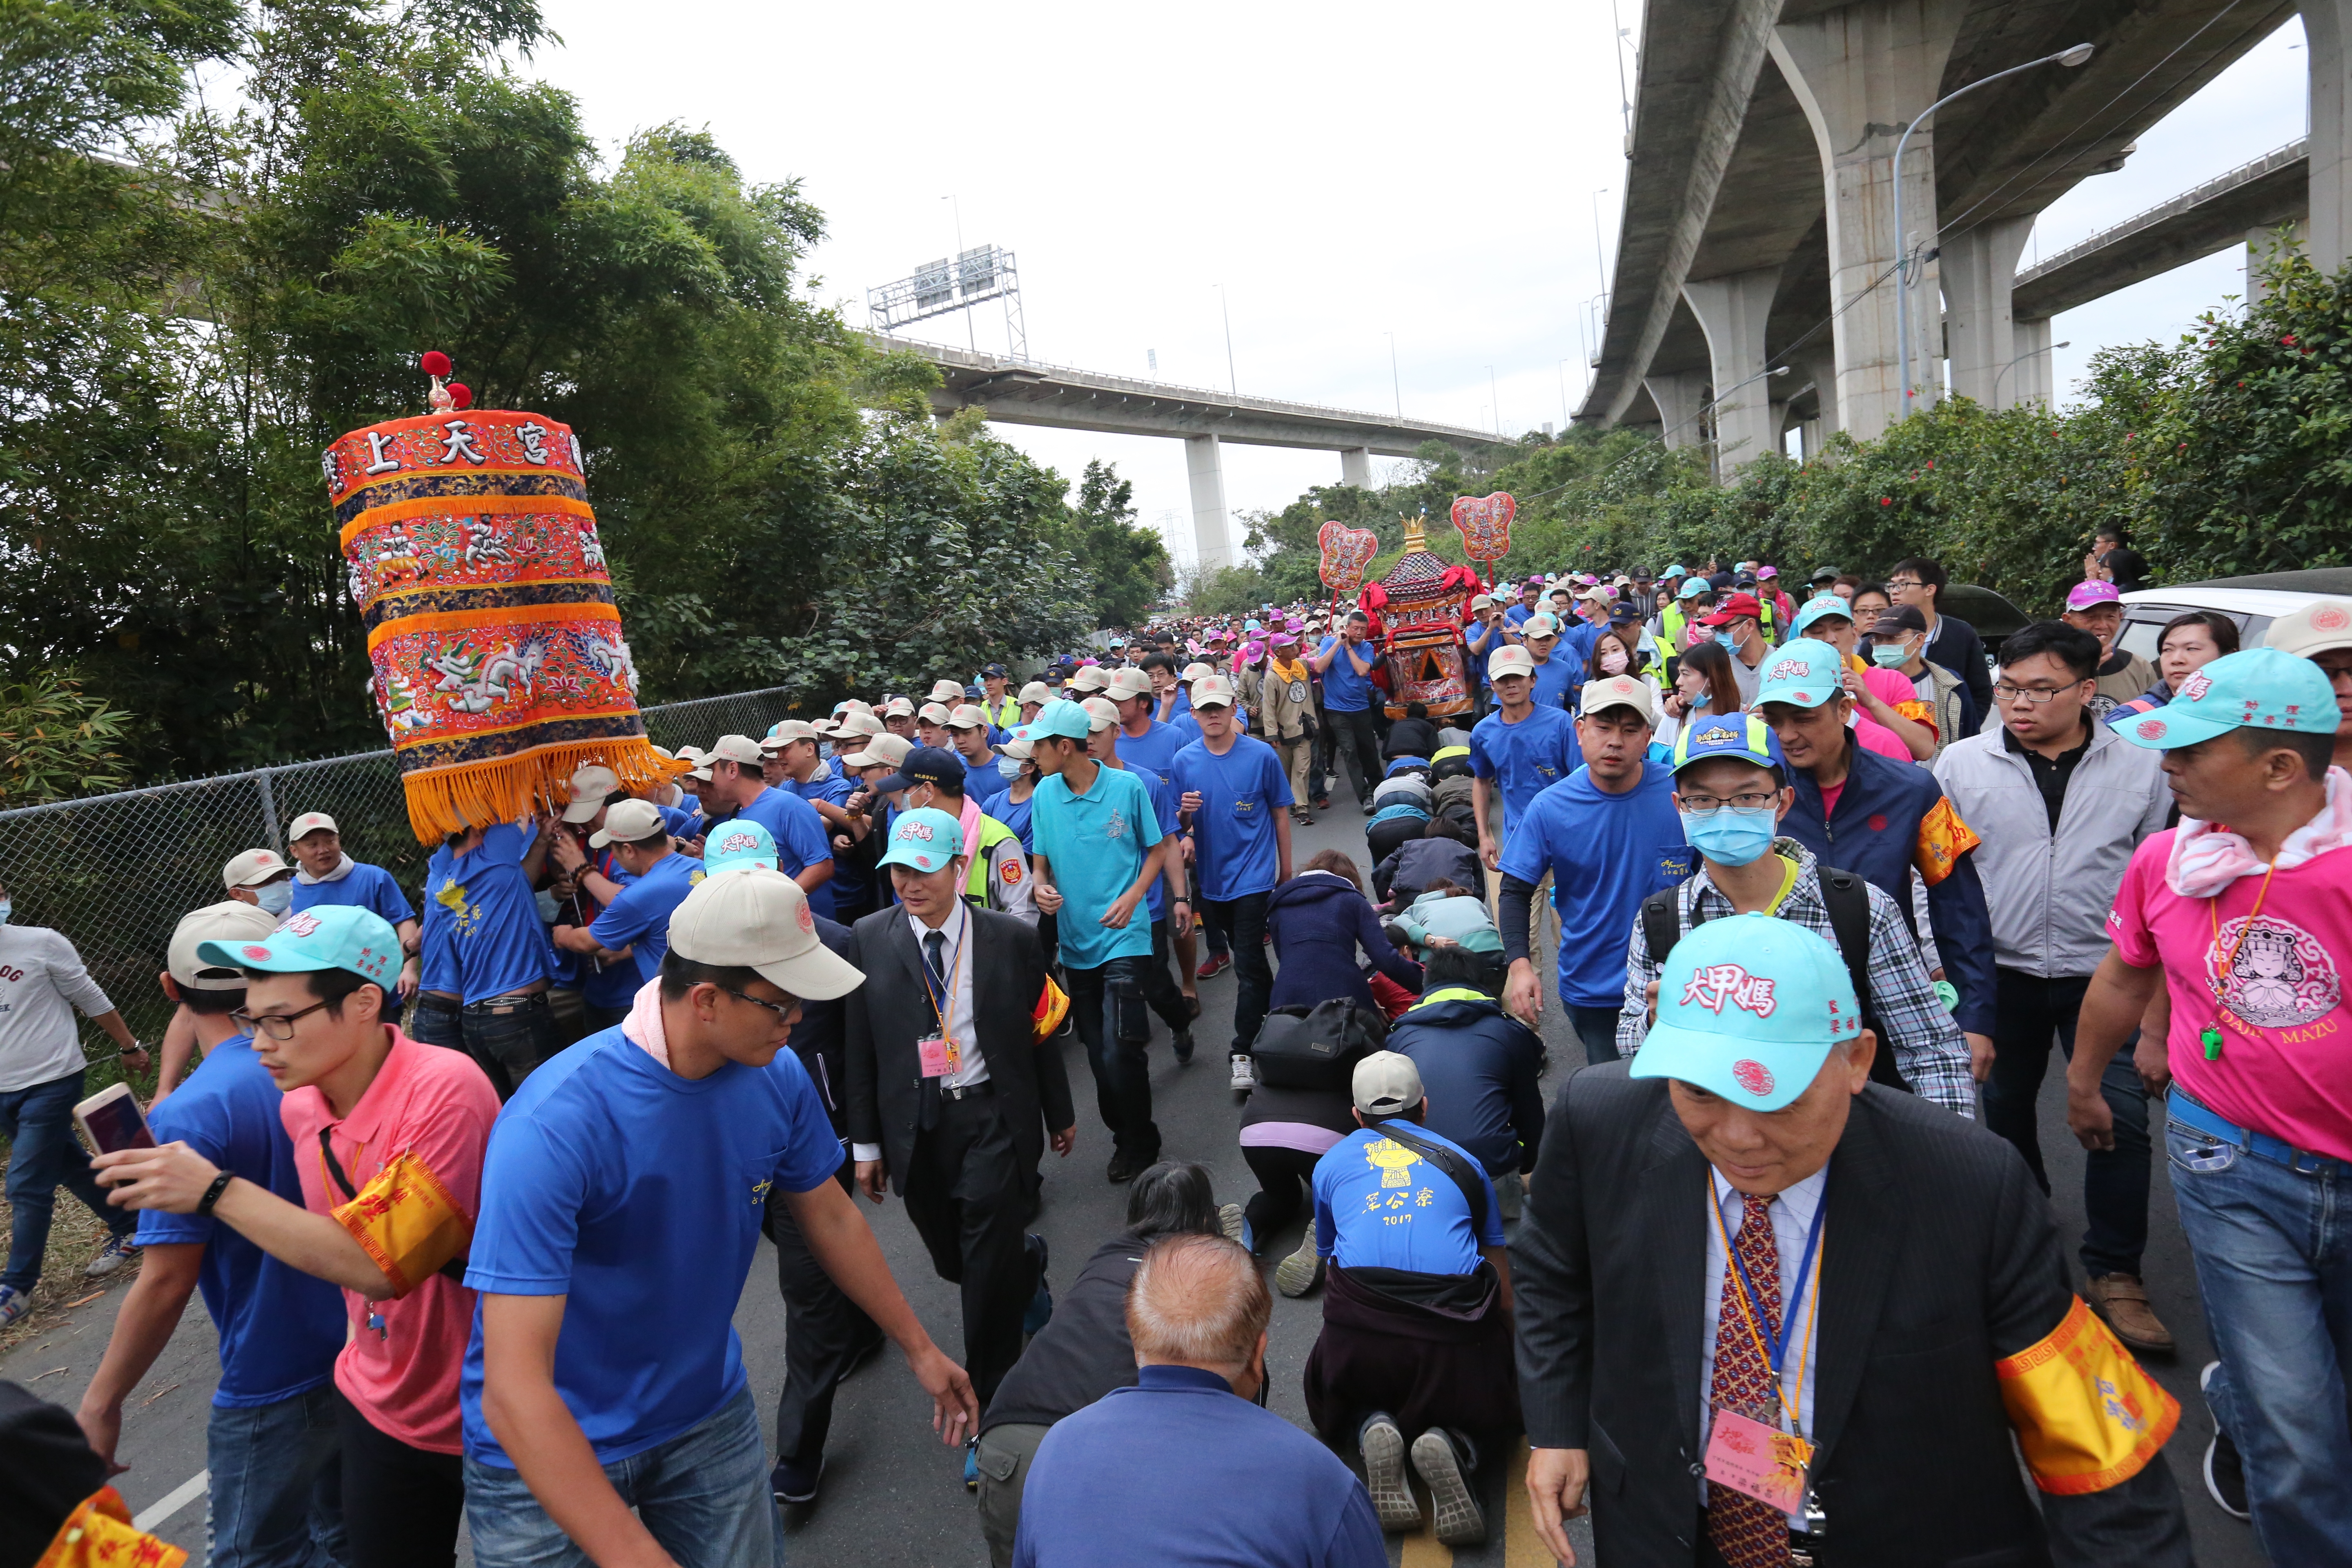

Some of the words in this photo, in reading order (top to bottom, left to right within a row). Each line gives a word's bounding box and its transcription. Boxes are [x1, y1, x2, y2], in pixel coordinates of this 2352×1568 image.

[365, 419, 548, 475] 上天宮
[1767, 659, 1810, 683] 大甲媽
[721, 833, 758, 854] 大甲媽
[895, 821, 934, 842] 大甲媽
[1679, 963, 1777, 1019] 大甲媽
[2279, 1018, 2338, 1044] MAZU
[1383, 1214, 1412, 1225] 2017
